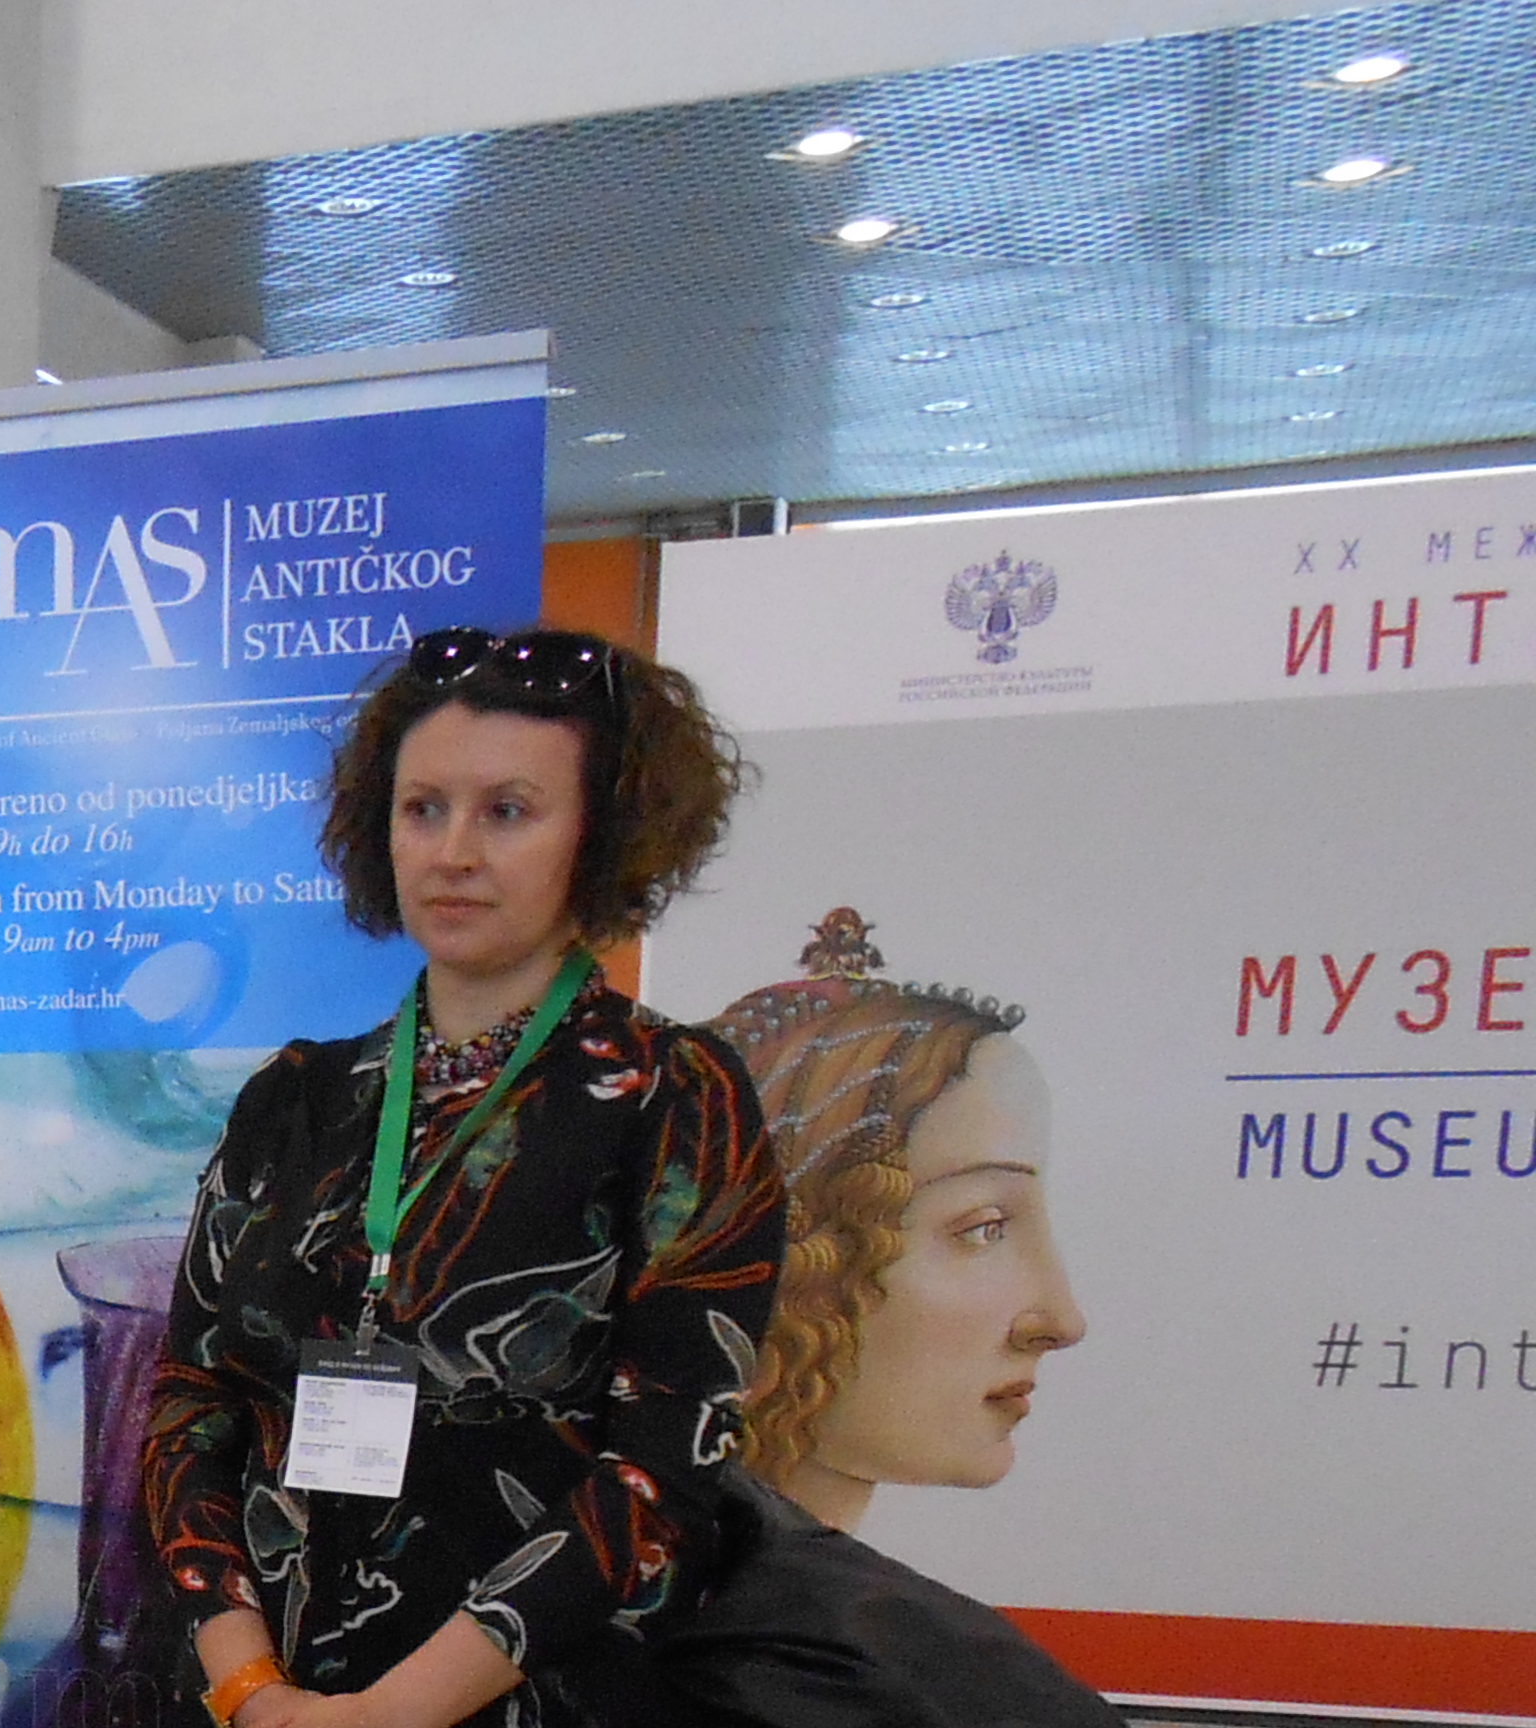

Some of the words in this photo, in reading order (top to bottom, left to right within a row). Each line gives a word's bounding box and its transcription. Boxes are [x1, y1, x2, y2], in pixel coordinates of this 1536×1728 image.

[245, 492, 386, 543] MUZEJ
[242, 546, 476, 603] ANTIČKOG
[244, 612, 414, 660] STAKLA
[20, 726, 87, 747] Ancient
[78, 784, 115, 812] od
[128, 772, 315, 819] ponedjeljka
[31, 825, 70, 856] do
[85, 823, 134, 853] 16h
[12, 881, 84, 913] from
[94, 877, 229, 915] Monday
[234, 879, 265, 905] to
[3, 924, 56, 954] 9am
[65, 924, 95, 951] to
[103, 921, 160, 956] 4pm
